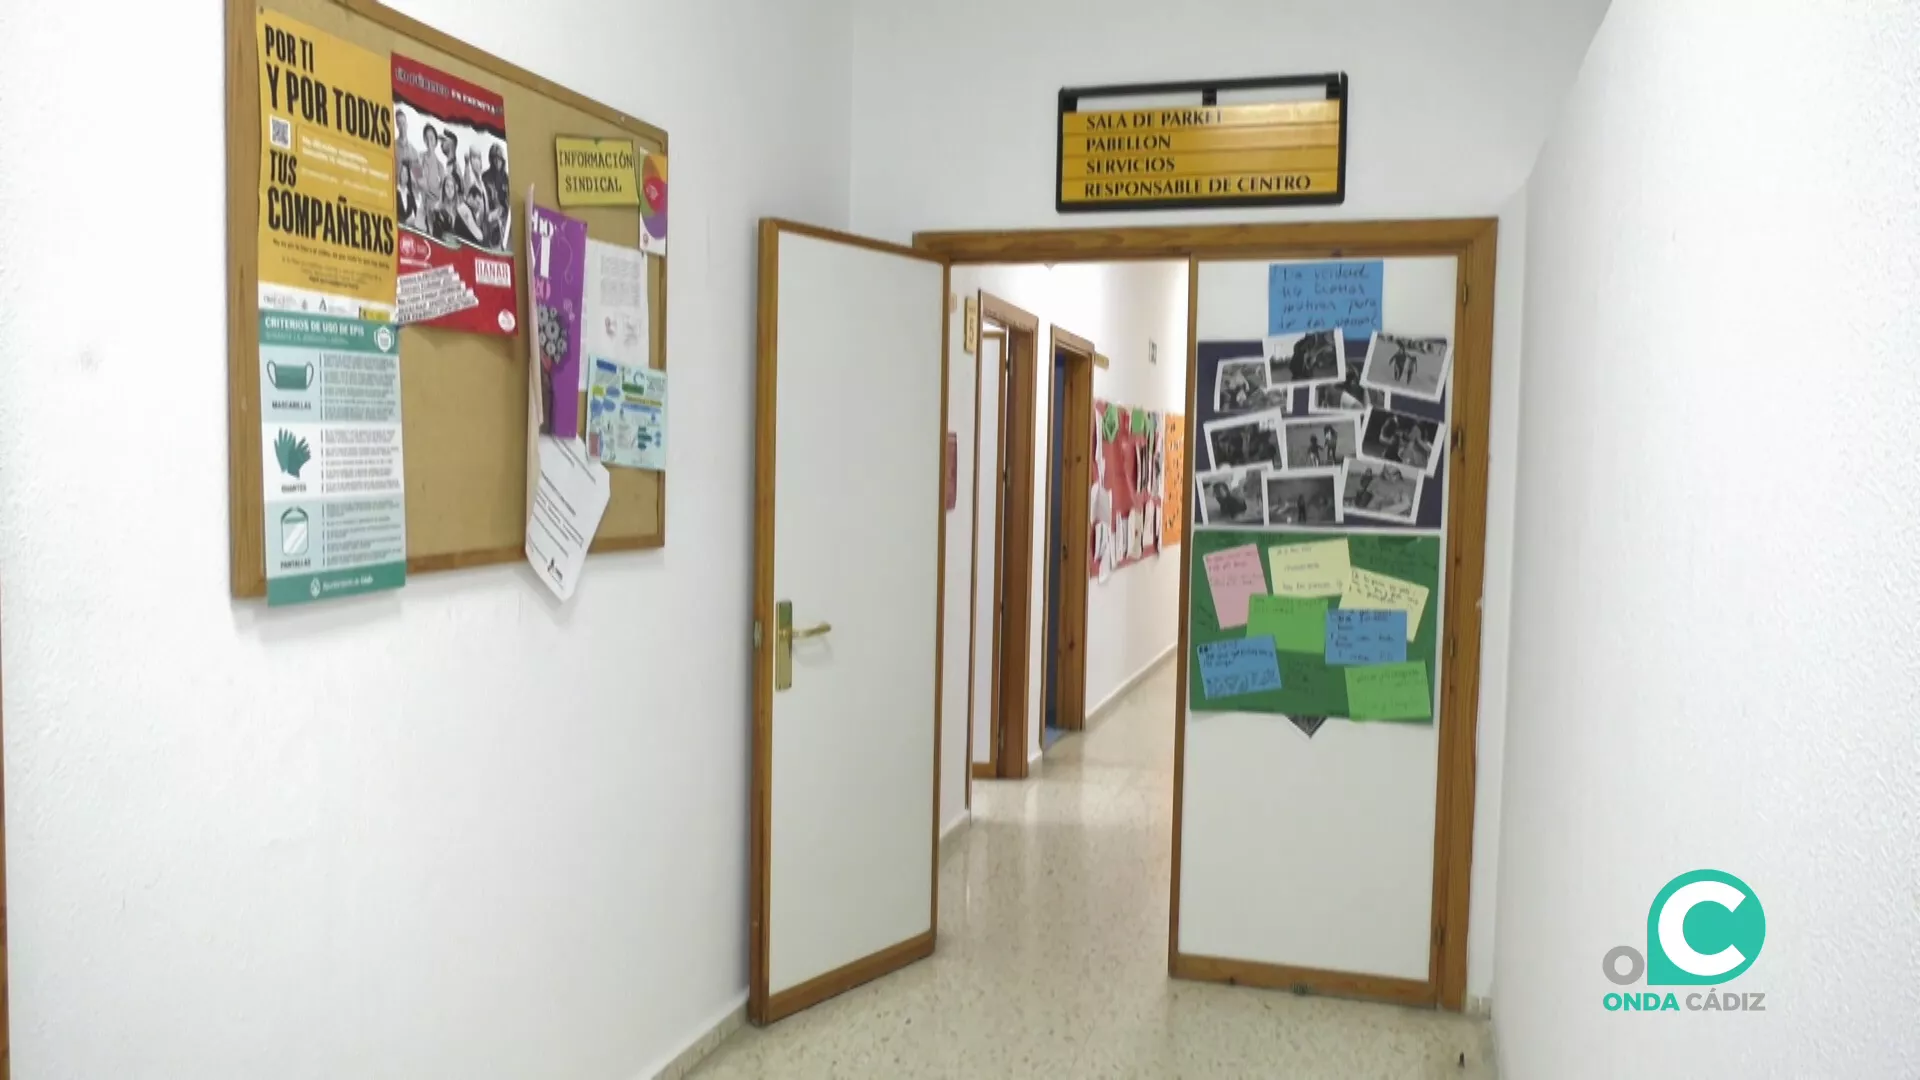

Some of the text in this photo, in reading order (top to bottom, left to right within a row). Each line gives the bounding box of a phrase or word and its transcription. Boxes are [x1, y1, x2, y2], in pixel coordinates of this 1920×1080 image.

[265, 23, 314, 74] POR TI
[266, 61, 391, 147] Y POR TODXS
[1086, 114, 1127, 131] SALA
[1133, 112, 1151, 129] DE
[1086, 135, 1171, 152] PABELLON
[270, 149, 297, 187] TUS
[559, 150, 633, 170] INFORMACIÓN
[1086, 156, 1175, 174] SERVICIOS
[565, 176, 622, 193] SINDICAL
[1085, 174, 1311, 198] RESPONSABLE DE CENTRO
[268, 185, 394, 256] COMPAÑERXS
[265, 316, 309, 333] CRITERIOS
[310, 321, 321, 331] DE
[323, 323, 338, 335] USO
[339, 325, 349, 335] DE
